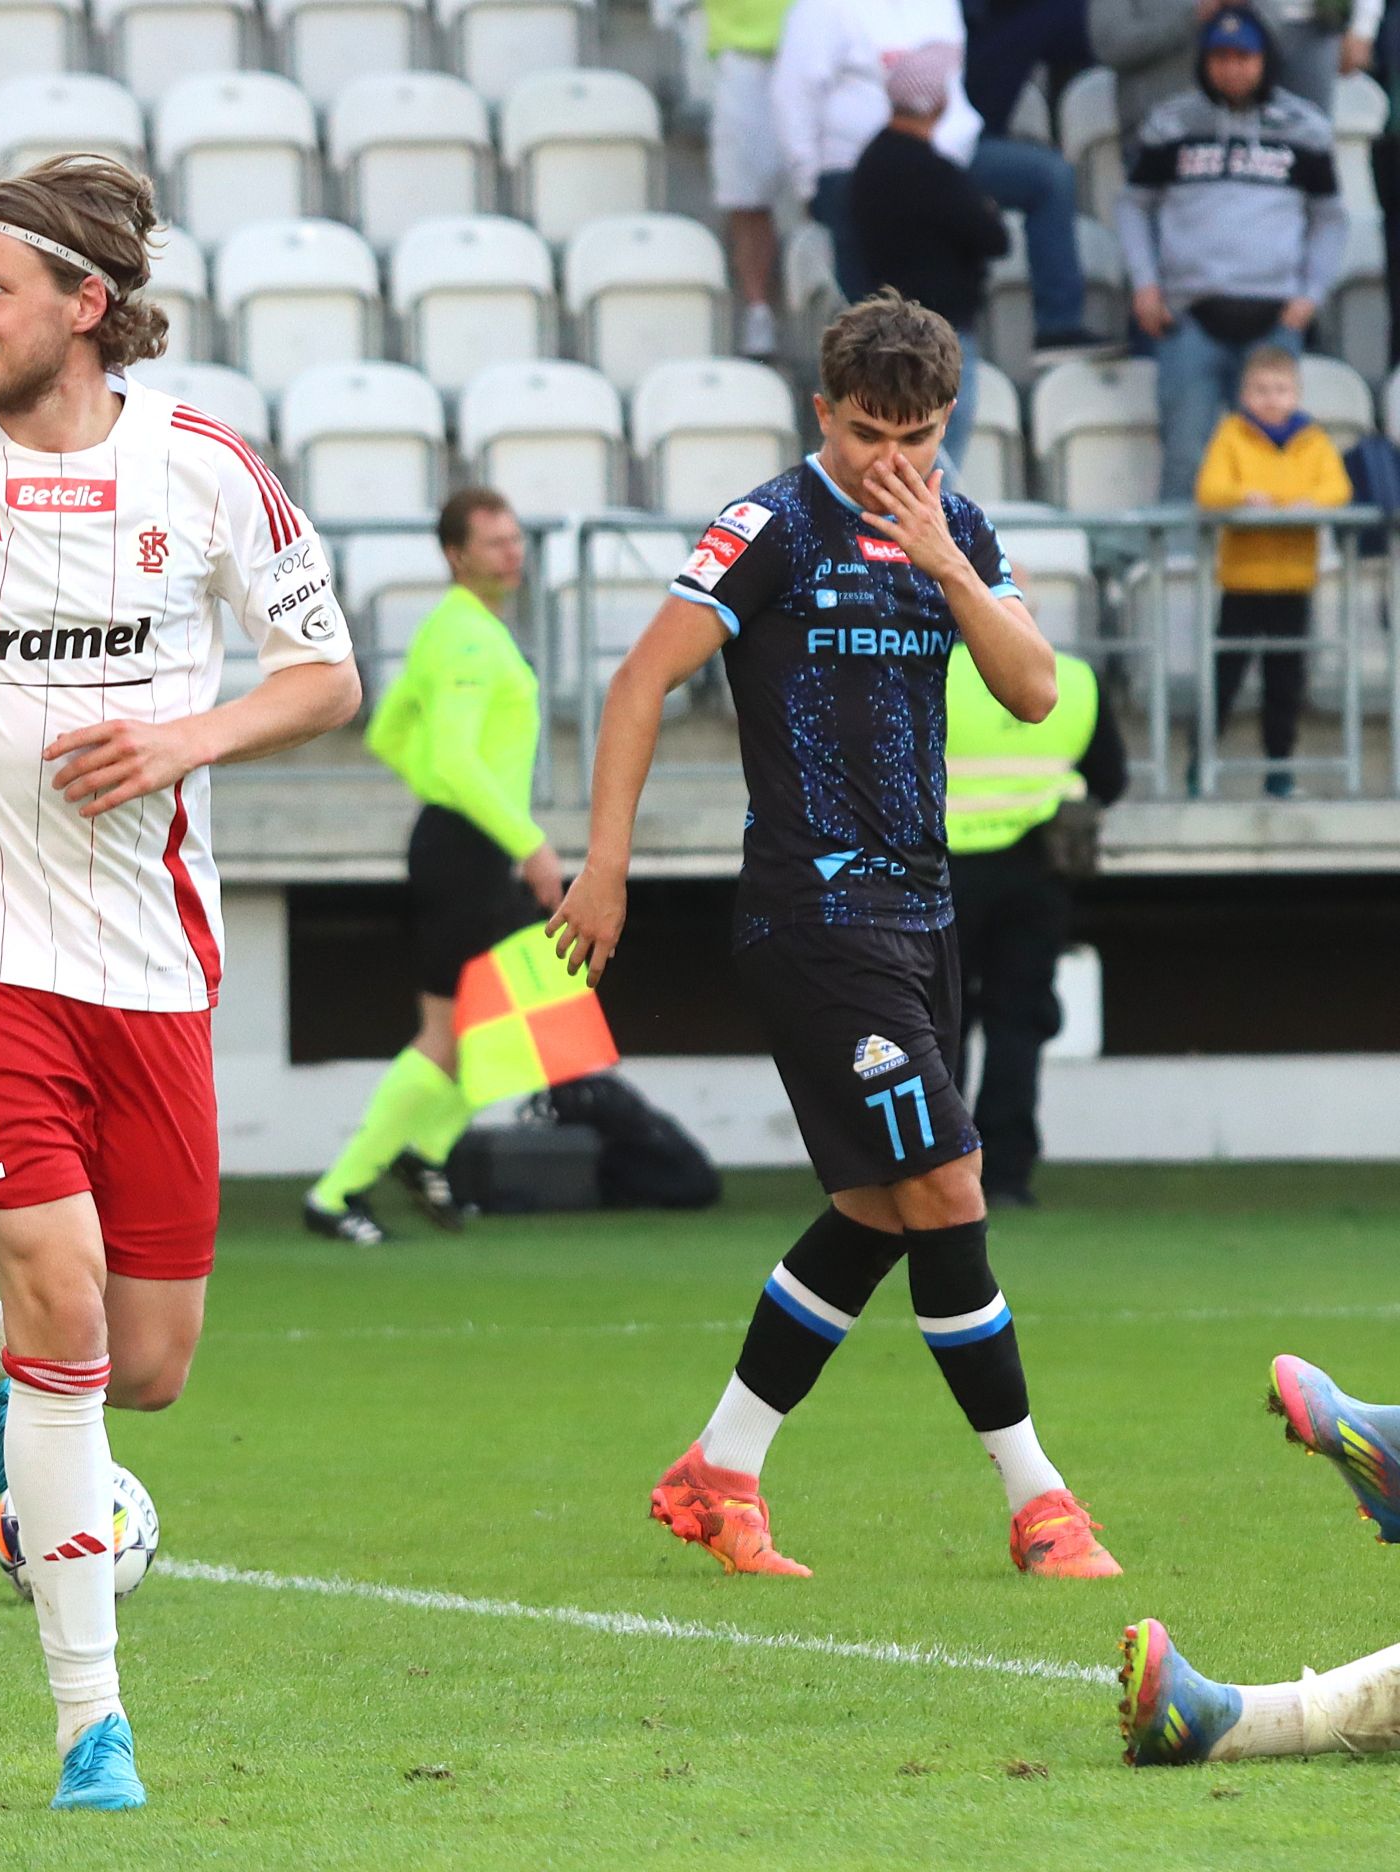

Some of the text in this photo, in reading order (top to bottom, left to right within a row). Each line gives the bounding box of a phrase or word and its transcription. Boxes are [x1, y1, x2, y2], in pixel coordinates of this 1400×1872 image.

[24, 233, 43, 245] ACE
[16, 484, 104, 508] Betclic
[807, 627, 952, 656] FIBRAIN
[865, 1075, 935, 1161] 77
